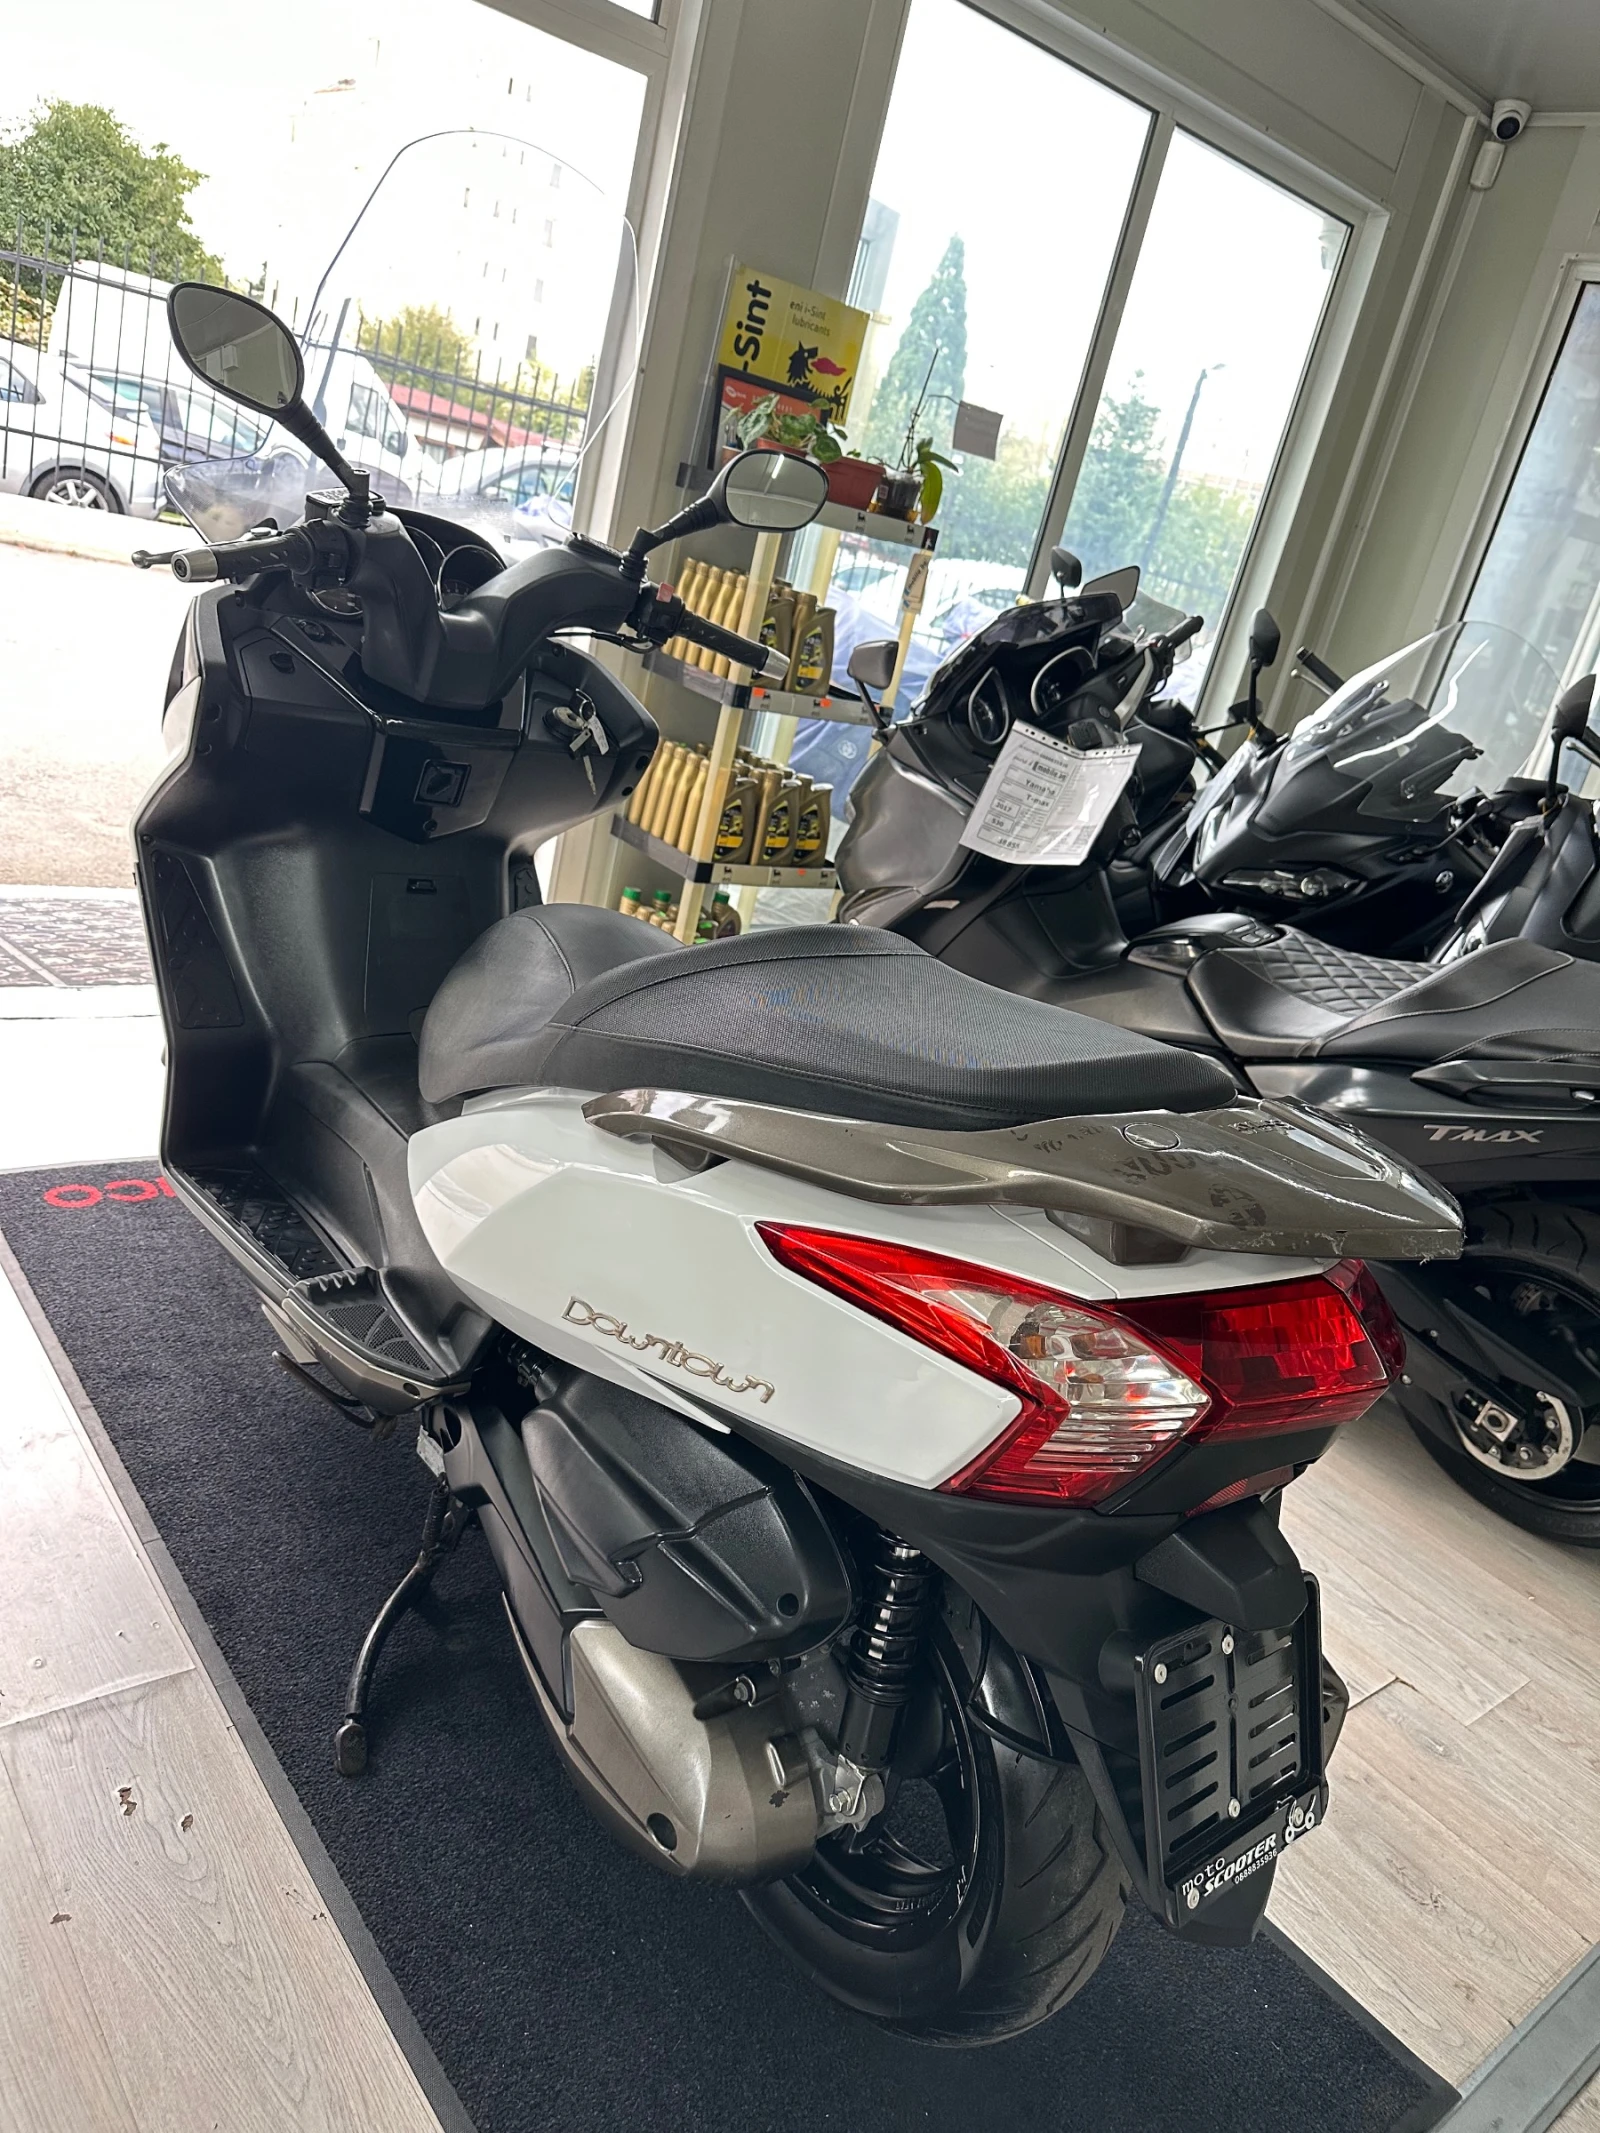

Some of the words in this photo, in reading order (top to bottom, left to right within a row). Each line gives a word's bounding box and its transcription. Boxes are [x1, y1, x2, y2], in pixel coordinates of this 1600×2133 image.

[792, 312, 831, 337] lubricants
[1423, 1124, 1544, 1143] TMAX
[561, 1295, 776, 1404] Downtown
[1182, 1857, 1226, 1896] moto
[1203, 1832, 1277, 1897] SCOOTER
